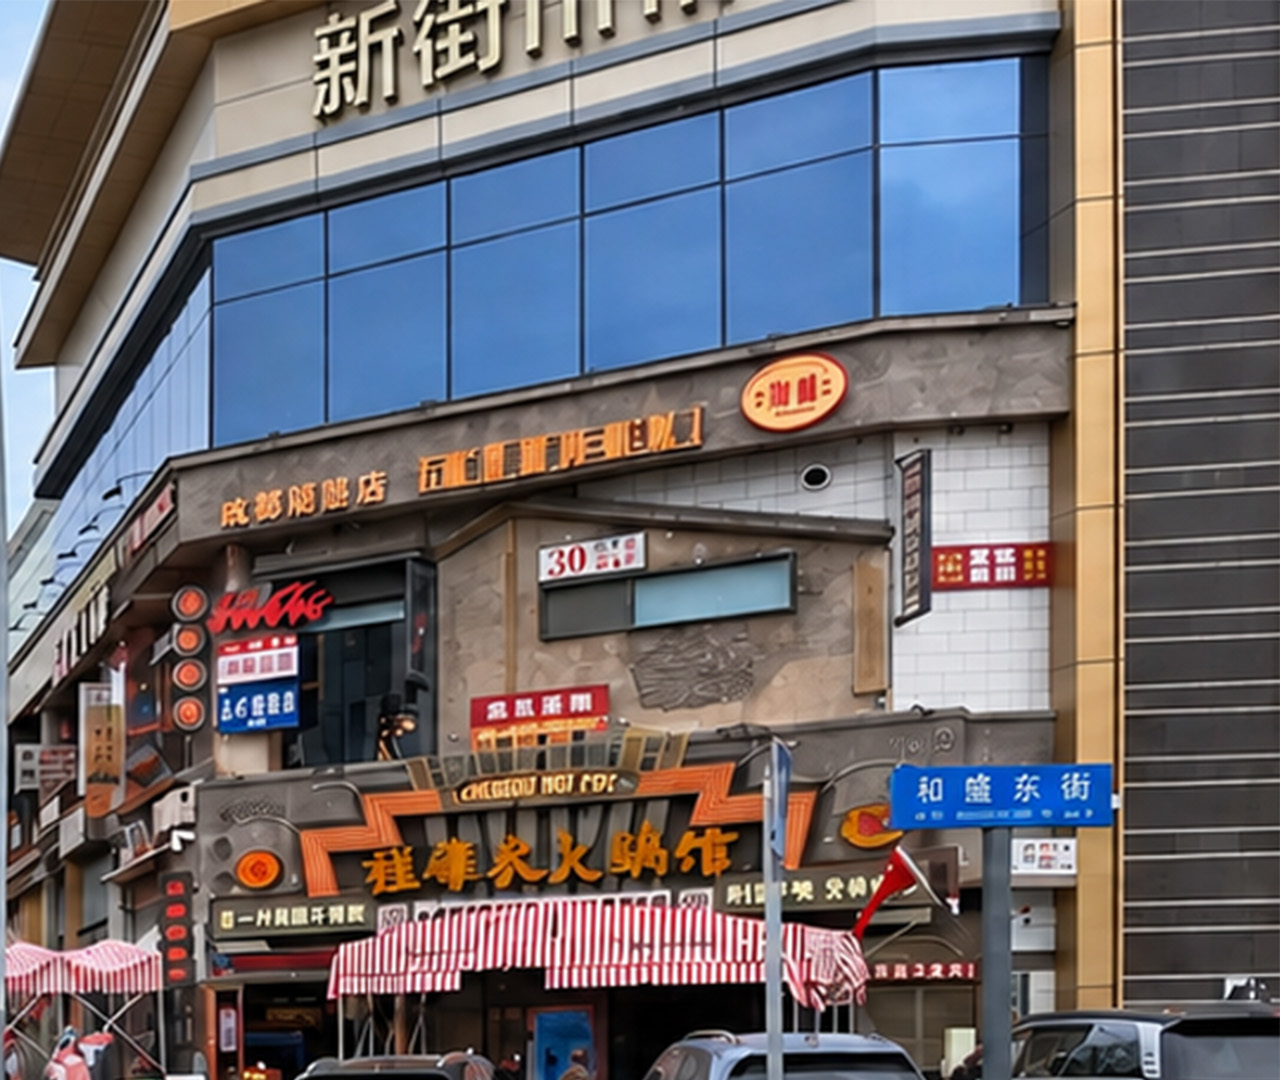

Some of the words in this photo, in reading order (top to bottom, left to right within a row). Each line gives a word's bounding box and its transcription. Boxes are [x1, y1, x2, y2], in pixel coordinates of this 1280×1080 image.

[546, 544, 587, 578] 30
[916, 772, 1091, 804] 和盛东街
